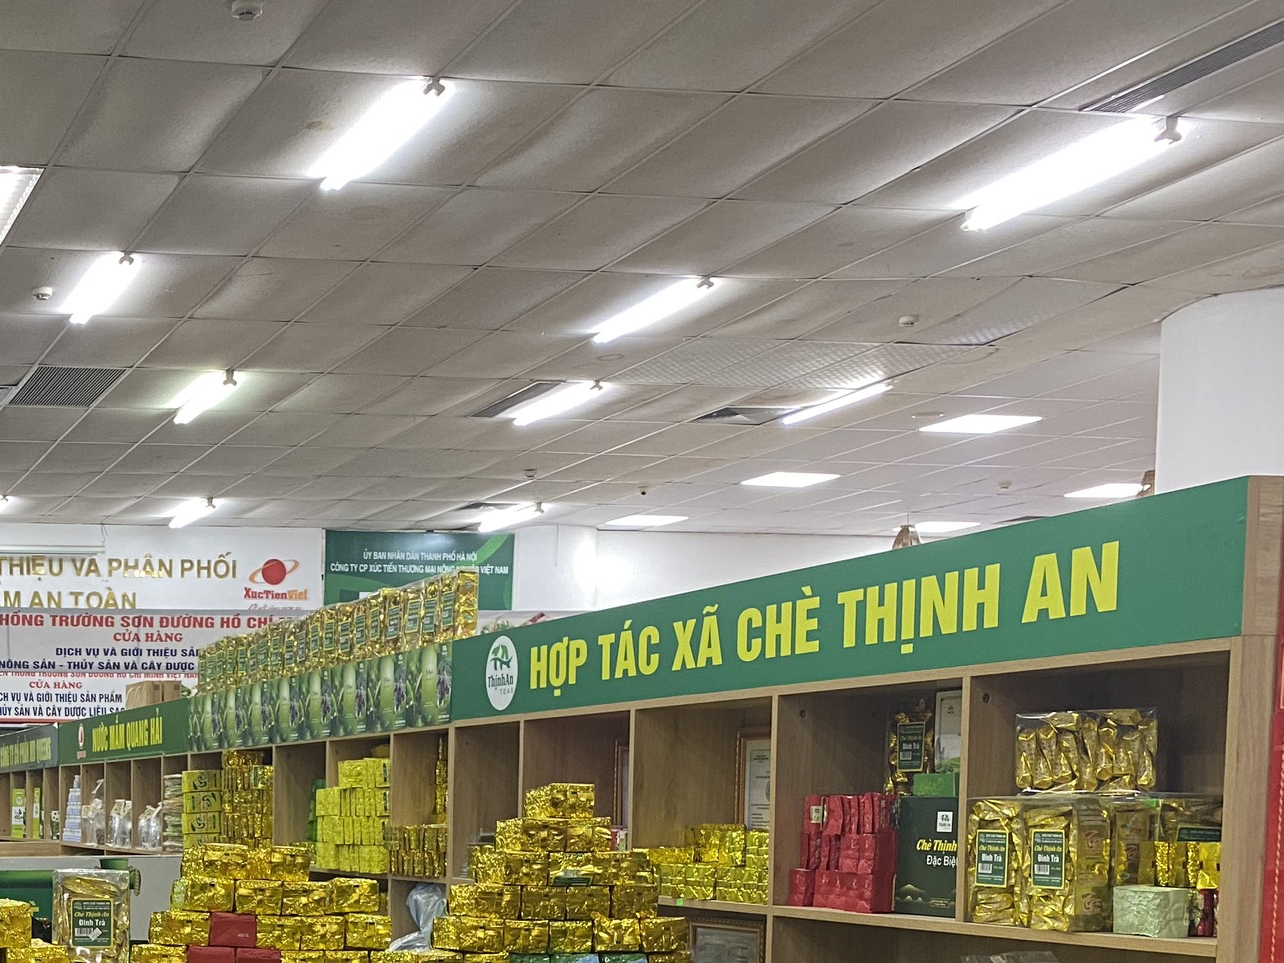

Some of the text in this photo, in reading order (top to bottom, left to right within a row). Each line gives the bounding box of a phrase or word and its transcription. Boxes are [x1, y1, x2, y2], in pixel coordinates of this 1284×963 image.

[373, 551, 387, 560] BAN
[108, 551, 237, 579] PHÂN PHỐI
[330, 562, 348, 572] CÔNG
[350, 564, 358, 572] TY
[495, 565, 508, 575] NAM
[29, 590, 62, 609] AN
[50, 613, 115, 628] TRƯỜNG
[120, 615, 154, 628] SƠN
[159, 614, 215, 629] ĐƯỜNG
[220, 613, 241, 628] HỒ
[529, 540, 1120, 697] HỢP TÁC XÃ CHÈ THỊNH AN
[113, 631, 183, 642] CỬA HÀNG
[55, 646, 177, 658] DỊCH VỤ VÀ GIỚI THIỆU
[33, 660, 56, 670] SẢN
[67, 660, 94, 670] THỦY
[97, 660, 121, 670] SẢN
[124, 660, 138, 670] VÀ
[141, 660, 162, 671] CÂY
[29, 680, 82, 689] CỬA HÀNG
[11, 692, 21, 703] VỤ
[23, 691, 34, 702] VÀ
[37, 692, 53, 703] GIỚI
[55, 693, 78, 703] THIỆU
[80, 691, 97, 703] SẢN
[99, 691, 122, 703] PHẨM
[14, 705, 30, 717] SẢN
[32, 705, 43, 717] VÀ
[46, 705, 62, 717] CÂY
[126, 718, 149, 751] QUANG
[916, 838, 957, 855] Chè Thịnh
[926, 854, 944, 868] Đặc
